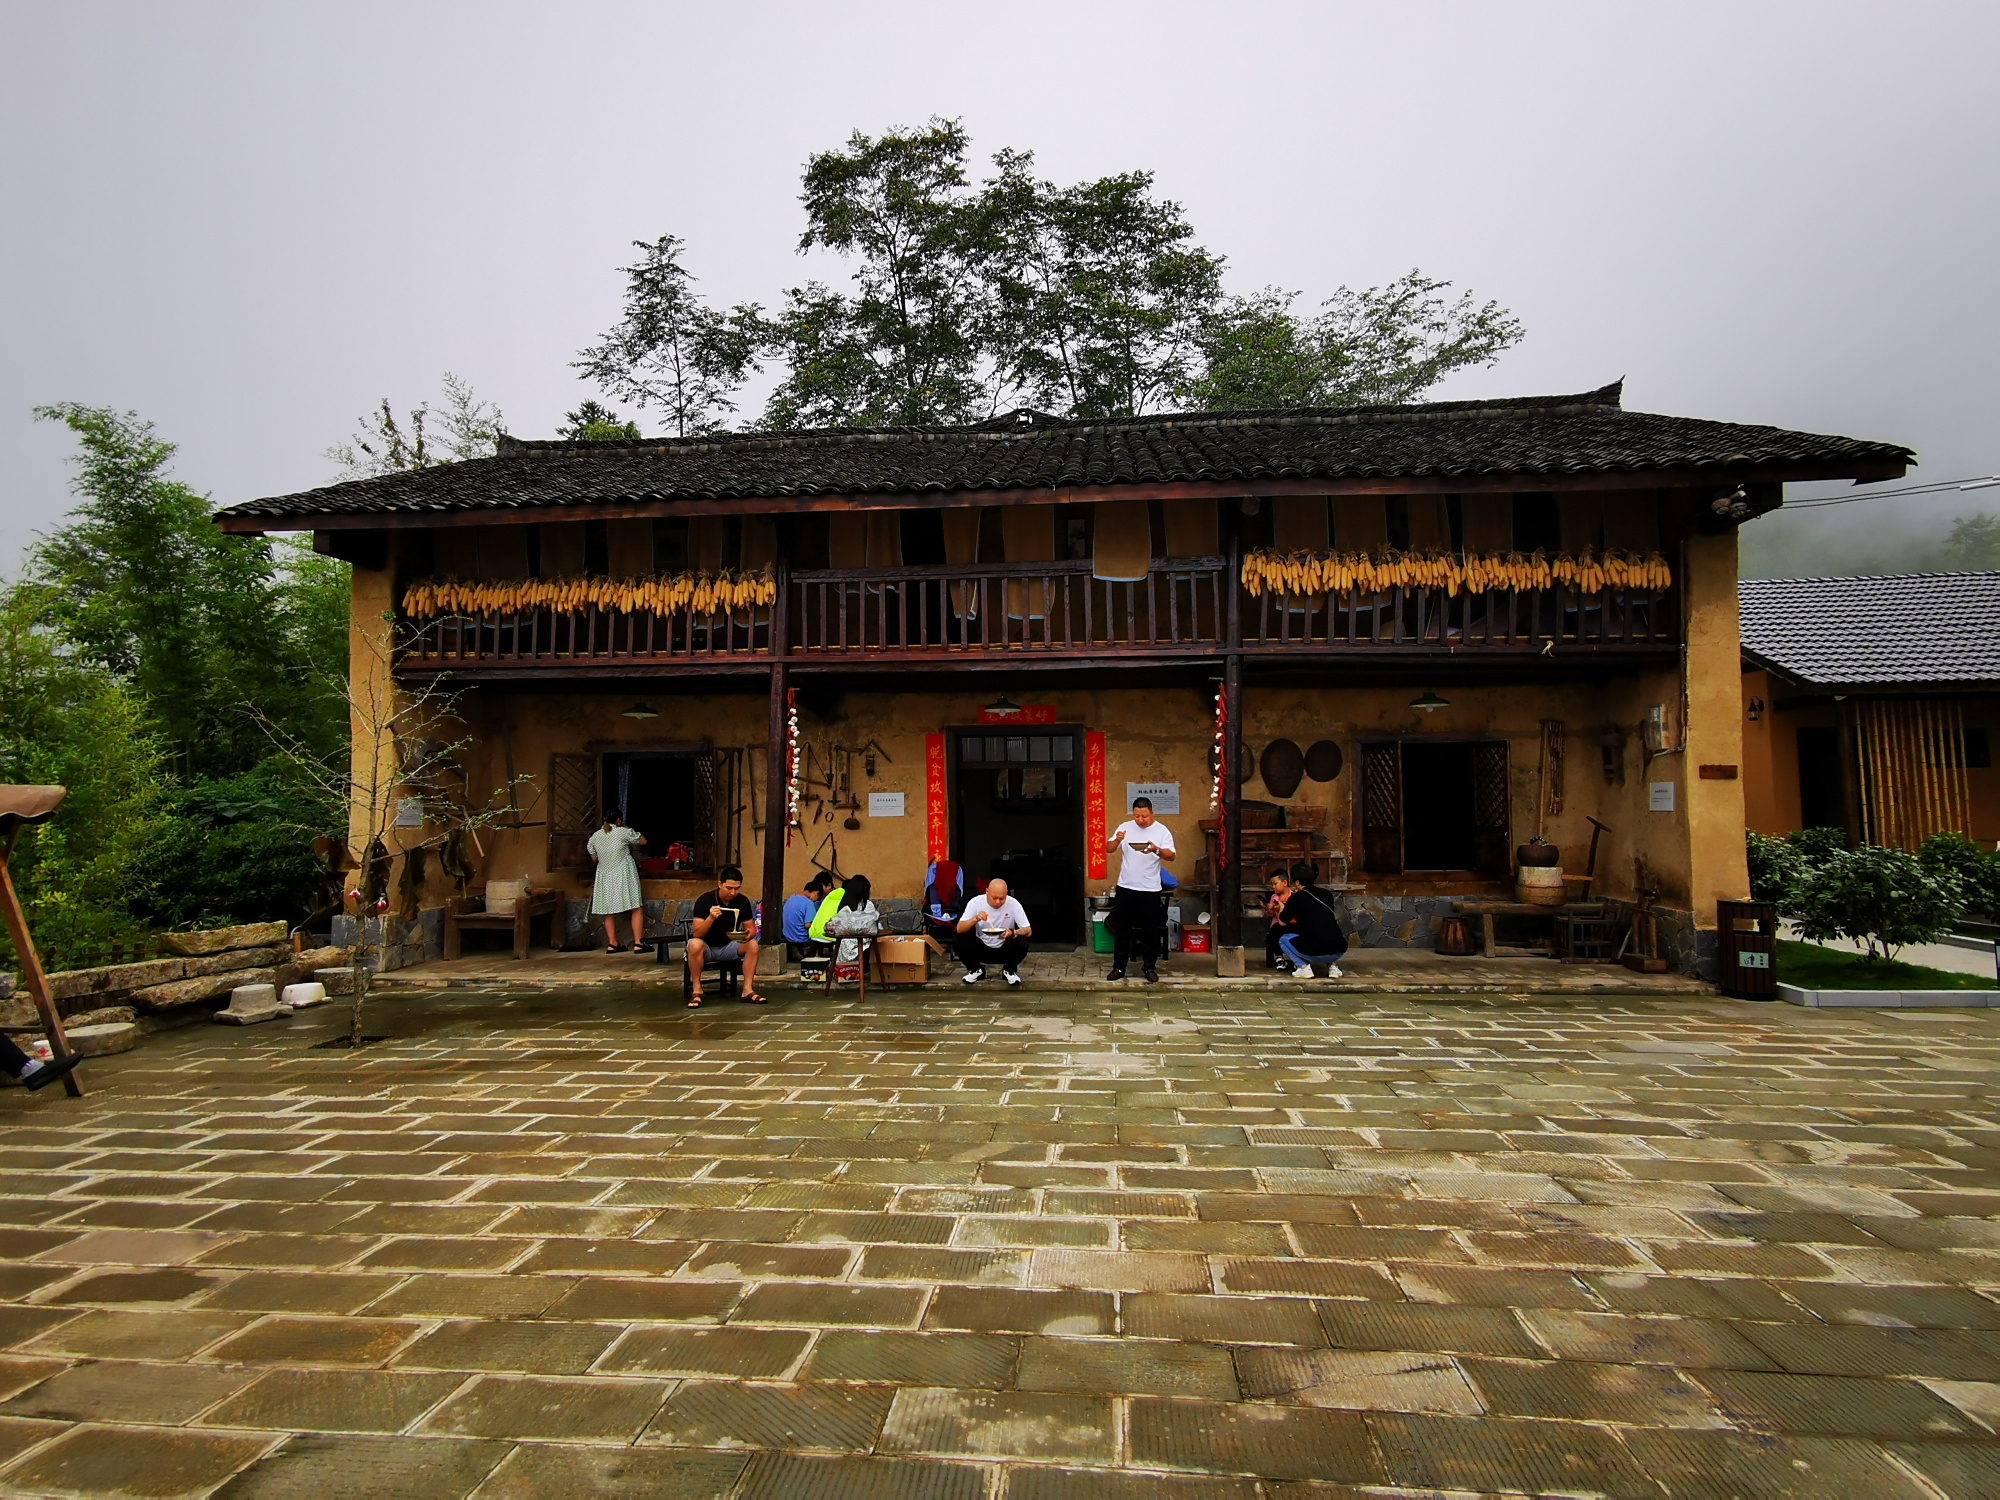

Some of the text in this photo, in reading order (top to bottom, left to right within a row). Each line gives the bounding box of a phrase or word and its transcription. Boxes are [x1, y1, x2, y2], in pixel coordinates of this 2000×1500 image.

[1088, 743, 1105, 867] 乡村振兴共富裕
